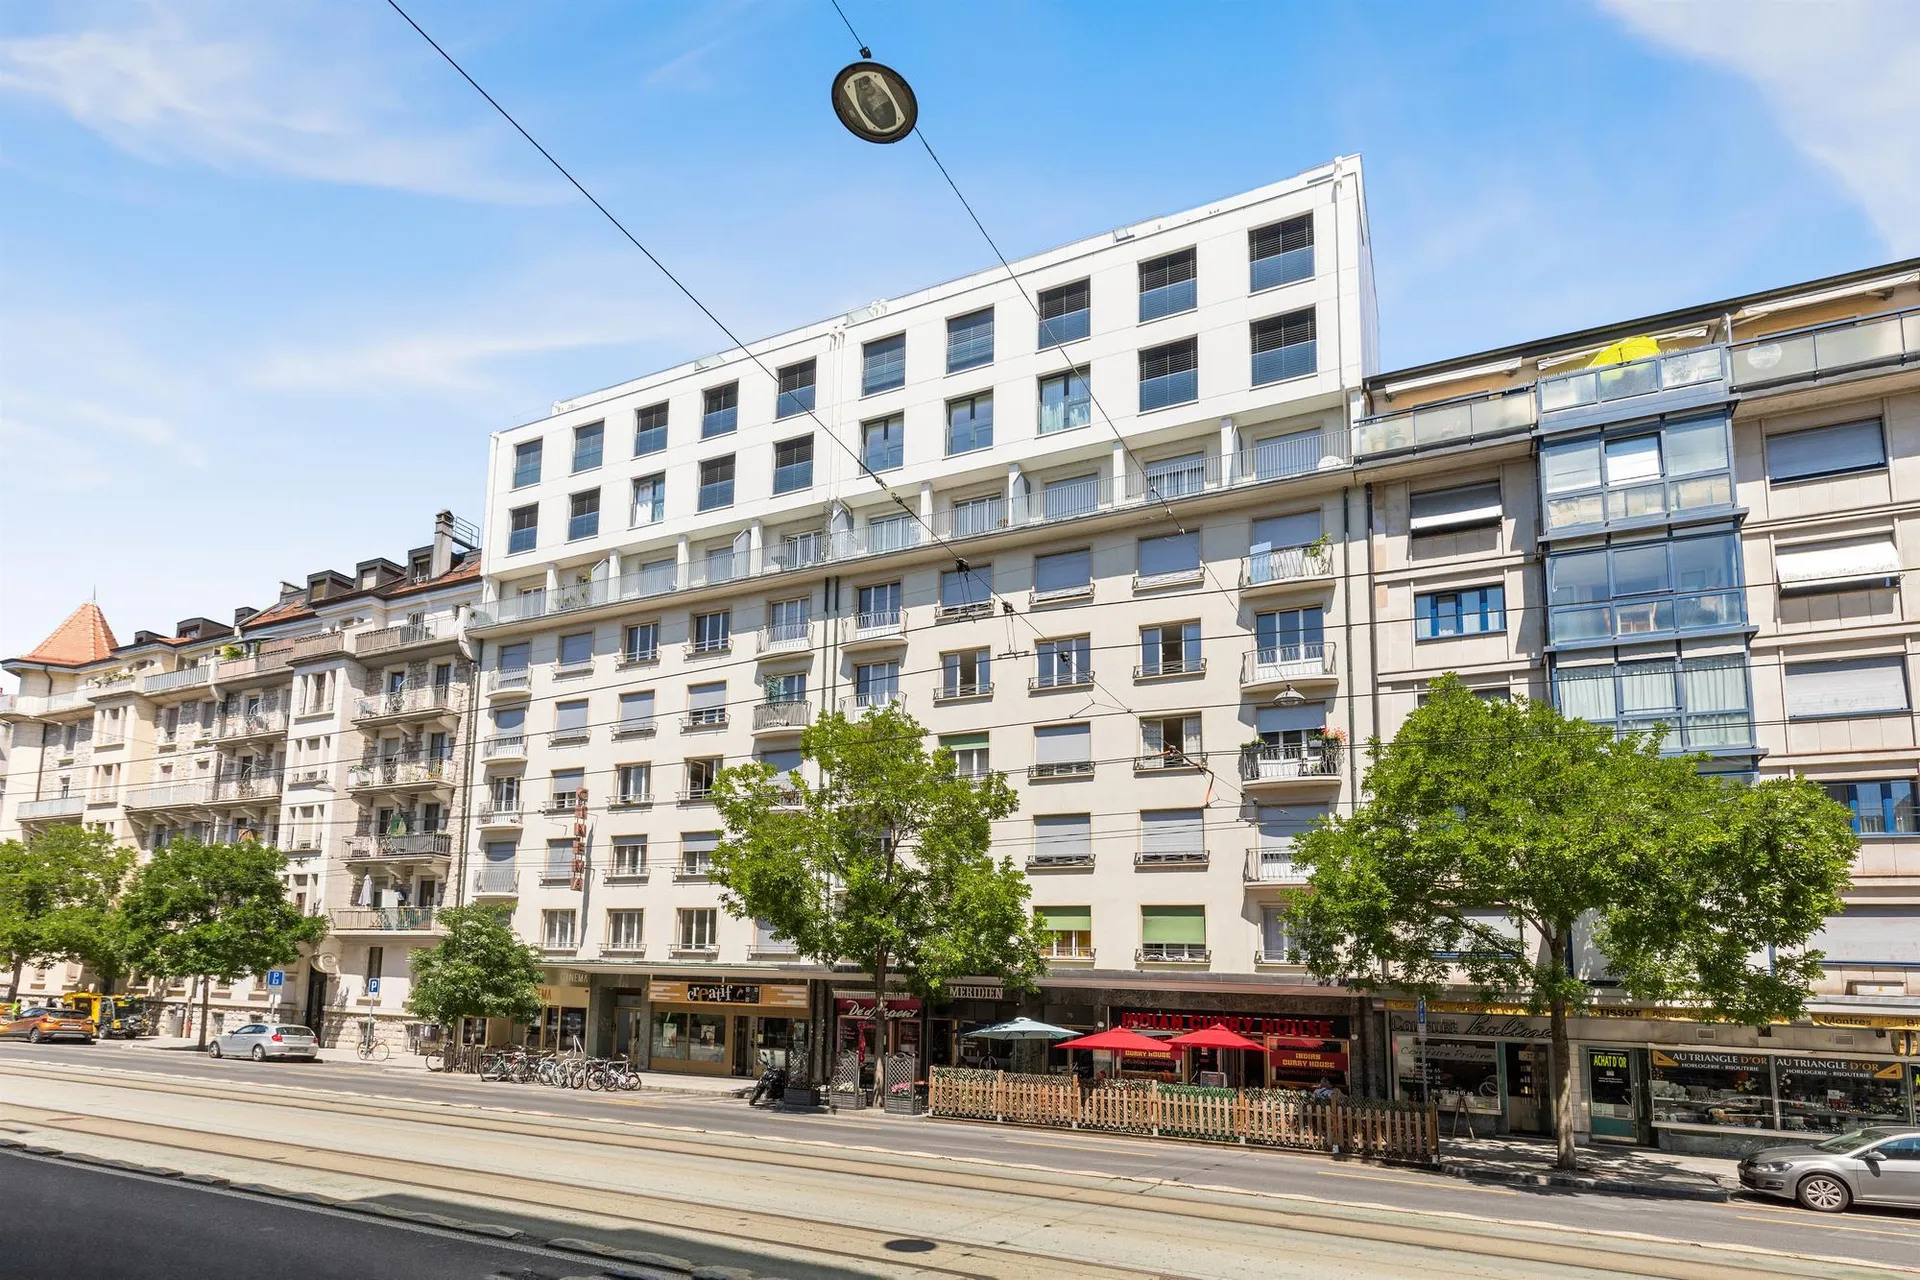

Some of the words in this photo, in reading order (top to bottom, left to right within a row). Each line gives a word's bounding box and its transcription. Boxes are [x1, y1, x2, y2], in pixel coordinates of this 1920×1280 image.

[949, 986, 1004, 999] MERIDIEN
[1600, 1008, 1641, 1017] TISSOT
[1121, 1013, 1183, 1030] INDIAN
[1261, 1017, 1333, 1037] HOUSE
[1824, 1016, 1871, 1026] Montres
[1295, 1052, 1321, 1060] INDIAN
[1672, 1052, 1687, 1061] AU
[1689, 1053, 1738, 1064] TRIANGLE
[1740, 1056, 1768, 1065] D'OR
[1282, 1059, 1308, 1067] CURRY
[1309, 1061, 1335, 1069] HOUSE
[1593, 1054, 1612, 1067] ACHAT
[1612, 1056, 1627, 1069] D'OR
[1681, 1062, 1720, 1070] HORLOGERIE
[1776, 1058, 1792, 1067] AU
[1795, 1059, 1847, 1070] TRIANGLE
[1849, 1061, 1879, 1071] D'OR
[1786, 1068, 1827, 1076] HORLOGERIE
